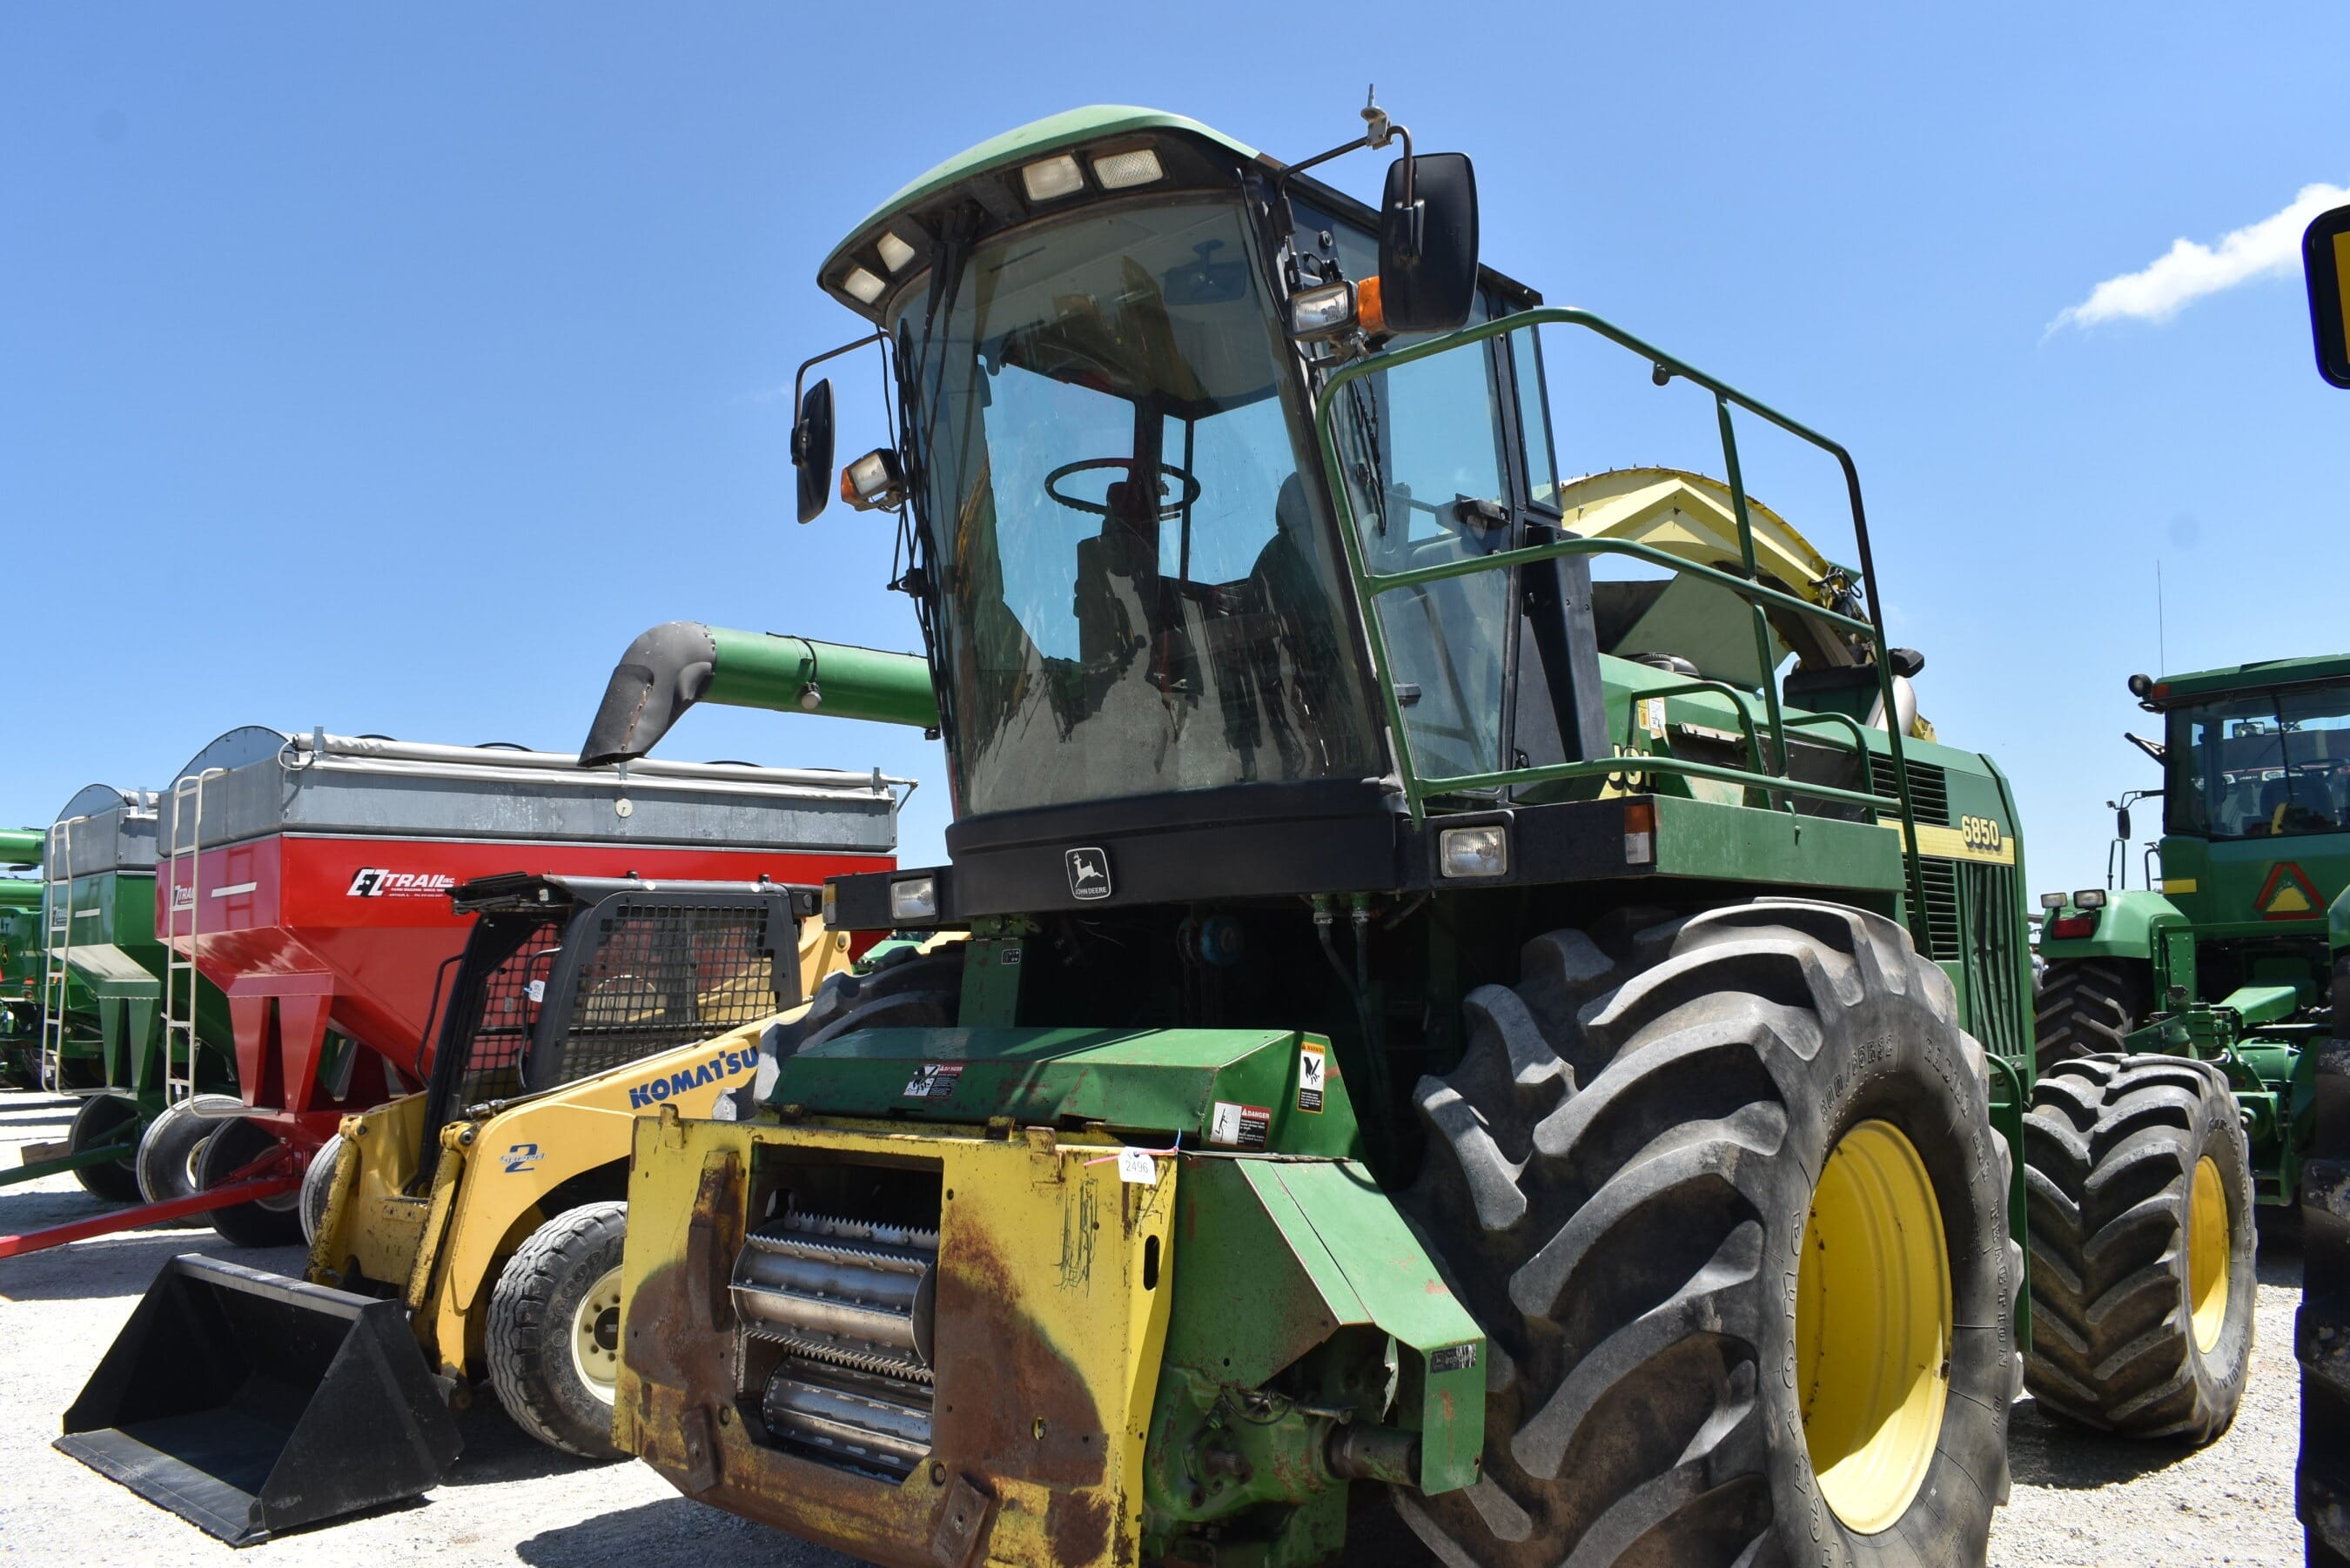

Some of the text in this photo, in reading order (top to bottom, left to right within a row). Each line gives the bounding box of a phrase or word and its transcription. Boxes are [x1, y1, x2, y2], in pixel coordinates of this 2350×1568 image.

[1961, 814, 2001, 849] 6850
[385, 874, 453, 888] TRAIL
[1088, 886, 1107, 895] DEERE
[628, 1046, 760, 1110] KOMATSU
[1247, 1110, 1270, 1119] DANGER
[1125, 1159, 1149, 1174] 2496
[1990, 1197, 2008, 1369] TRACTION
